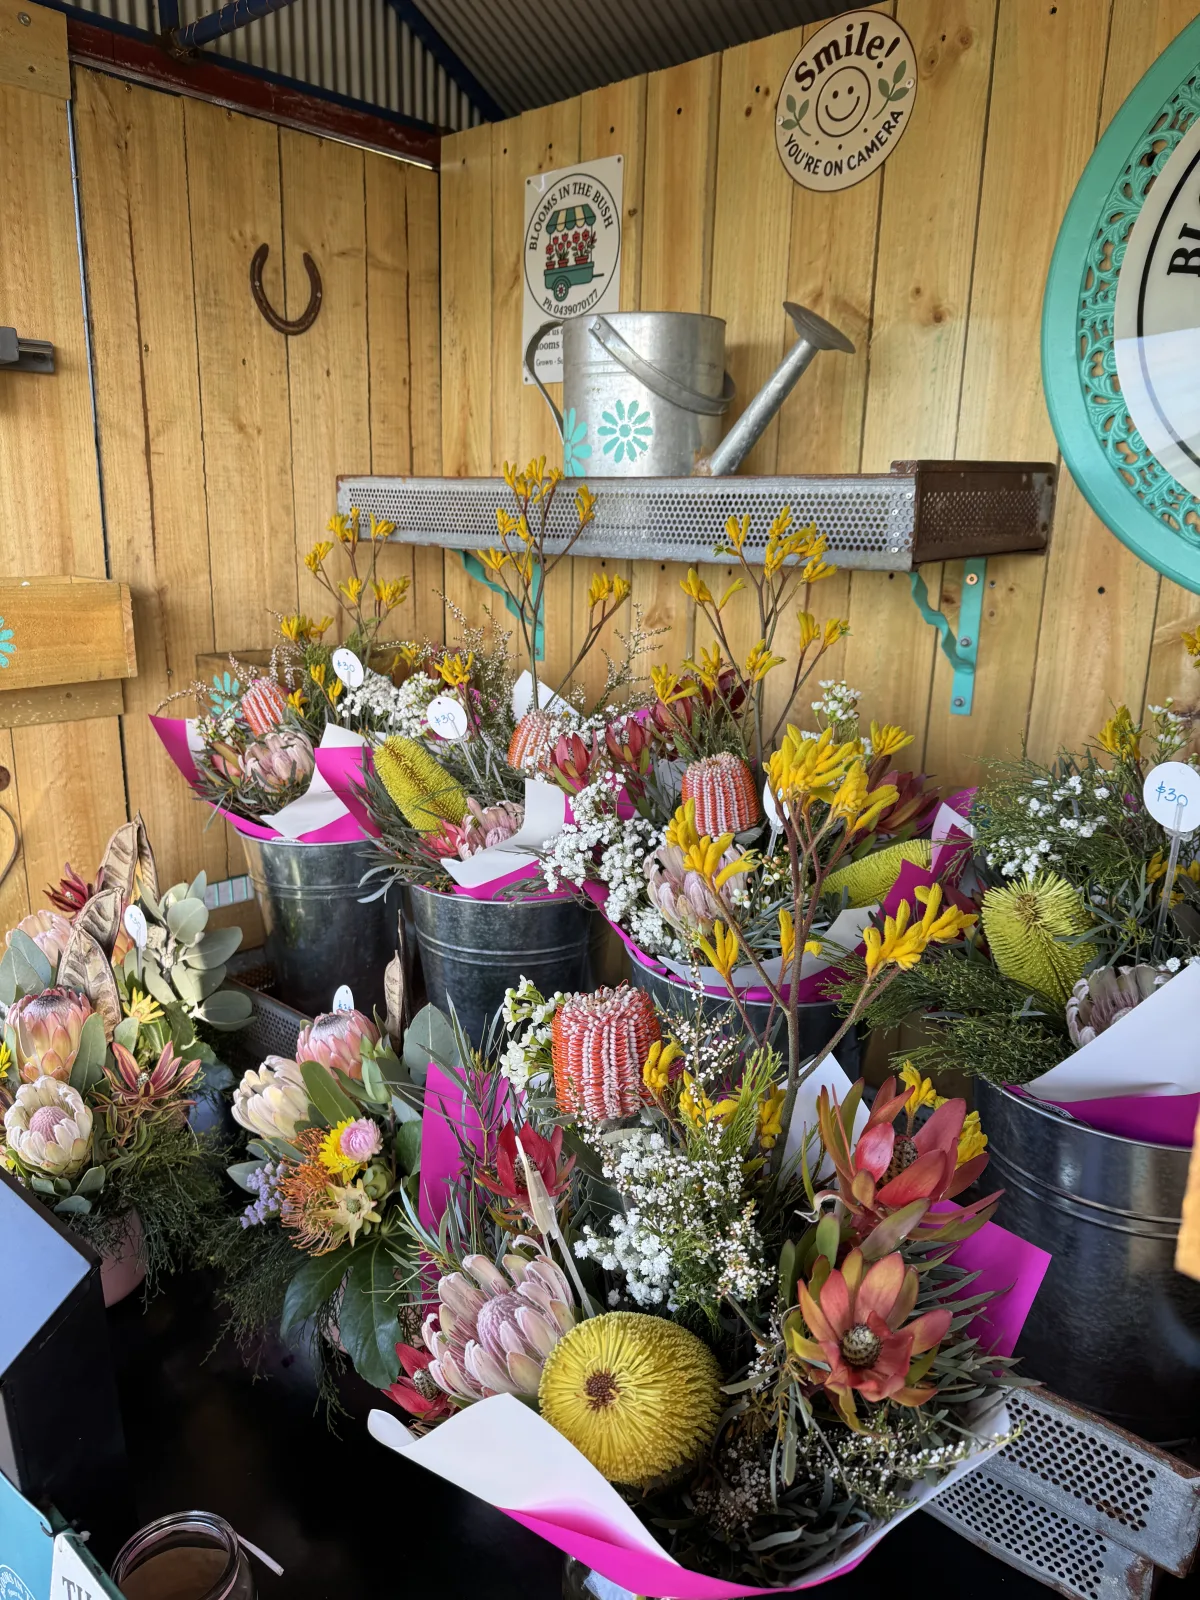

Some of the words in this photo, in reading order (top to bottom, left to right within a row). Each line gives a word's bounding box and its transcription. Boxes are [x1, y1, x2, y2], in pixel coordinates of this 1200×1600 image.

[795, 21, 901, 92] Smile!
[784, 133, 822, 176] YOU'RE
[823, 159, 843, 177] ON
[847, 110, 904, 171] CAMERA
[529, 193, 558, 251] BLOOMS
[559, 184, 571, 200] IN
[572, 182, 593, 198] THE
[592, 190, 614, 230] BUSH
[1166, 222, 1200, 278] BL
[542, 297, 553, 312] Ph
[553, 288, 599, 316] 0439070177
[537, 341, 560, 350] ooms
[337, 660, 356, 673] $30
[434, 712, 456, 726] $30
[1155, 780, 1189, 807] $30
